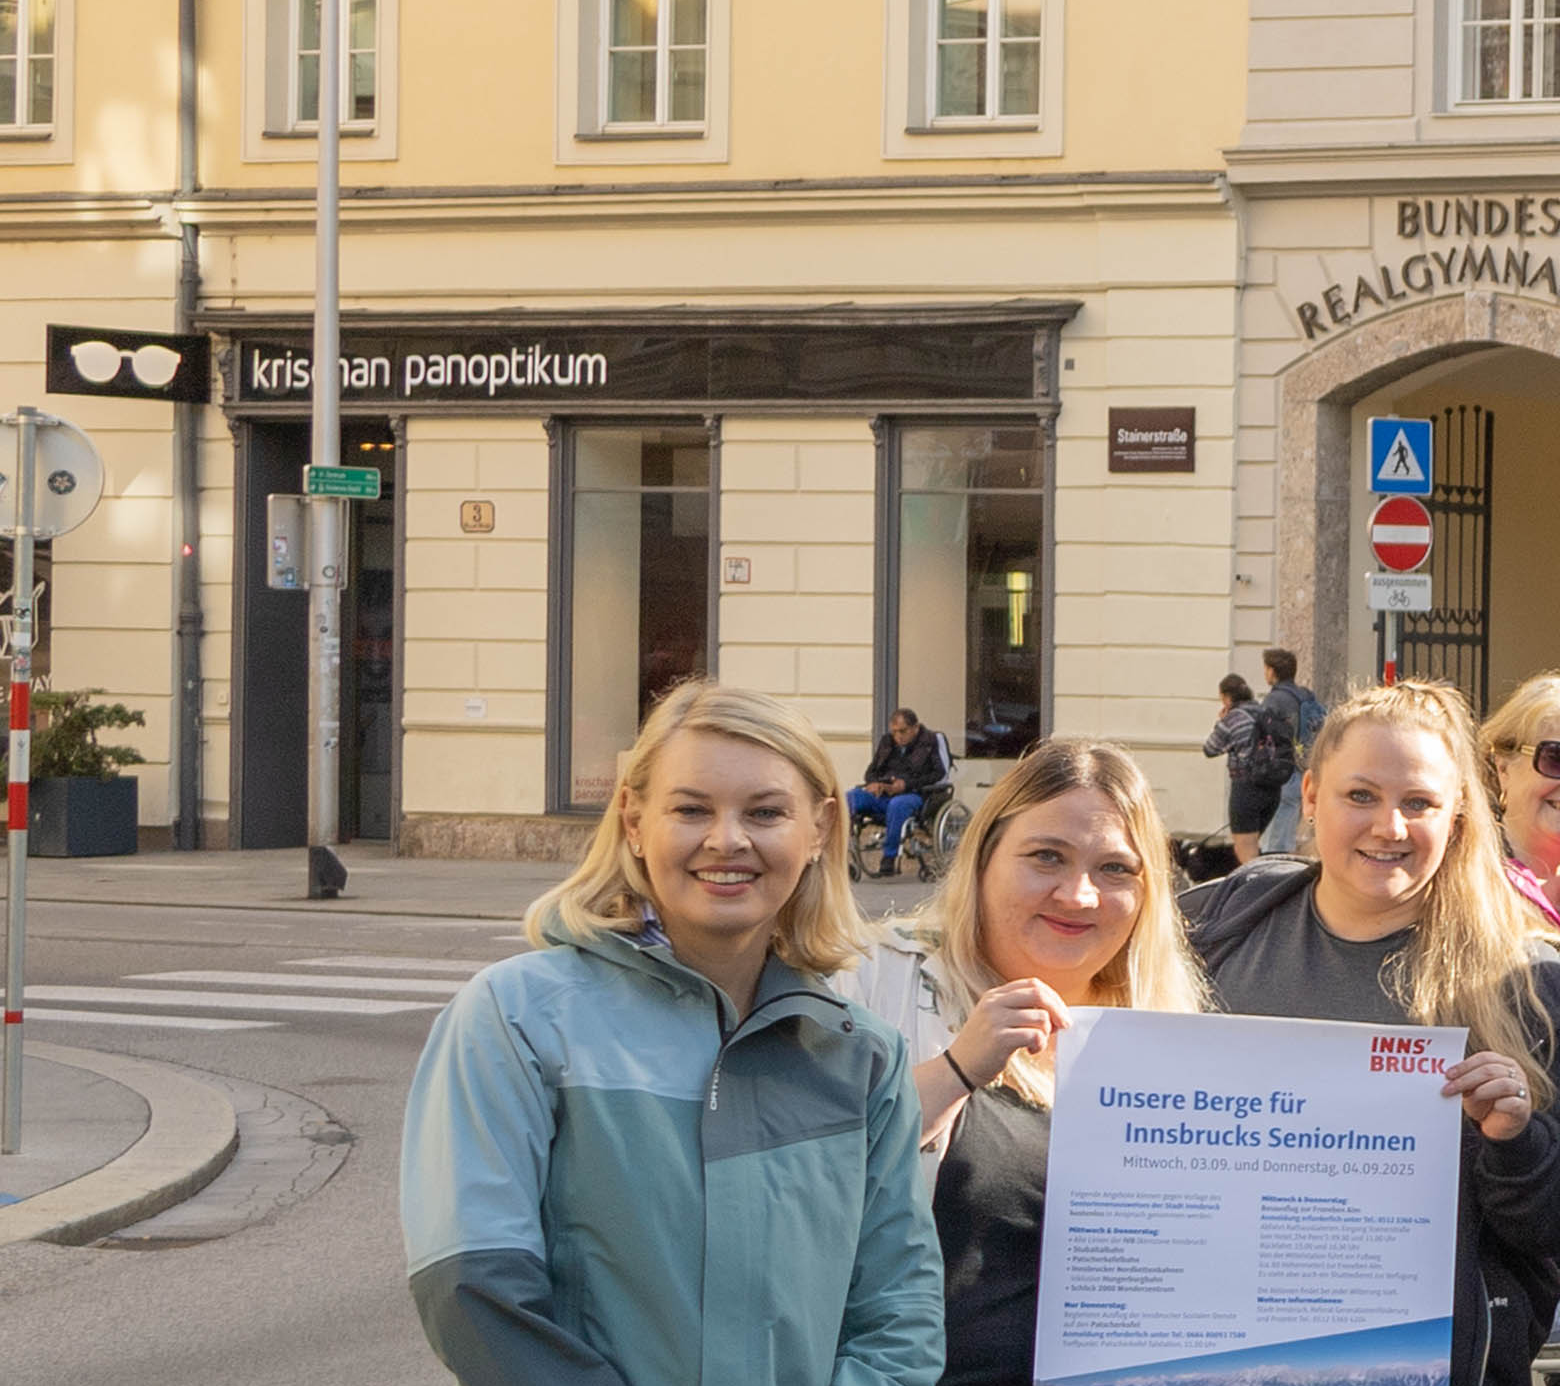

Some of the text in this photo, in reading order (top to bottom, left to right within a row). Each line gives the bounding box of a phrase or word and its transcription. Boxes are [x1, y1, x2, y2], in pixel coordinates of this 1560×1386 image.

[253, 344, 607, 397] krisan panoptikum
[1118, 428, 1188, 444] Stainerstraße
[473, 504, 481, 522] 3
[1370, 1056, 1446, 1074] BRUCK
[1100, 1086, 1306, 1118] Unsere Berge für
[1125, 1122, 1415, 1151] Innsbrucks SeniorInnen
[1123, 1156, 1187, 1171] Mittwoch,
[1234, 1160, 1259, 1172] und
[1263, 1160, 1339, 1177] Donnerstag,
[1342, 1162, 1415, 1176] 04.09.2025
